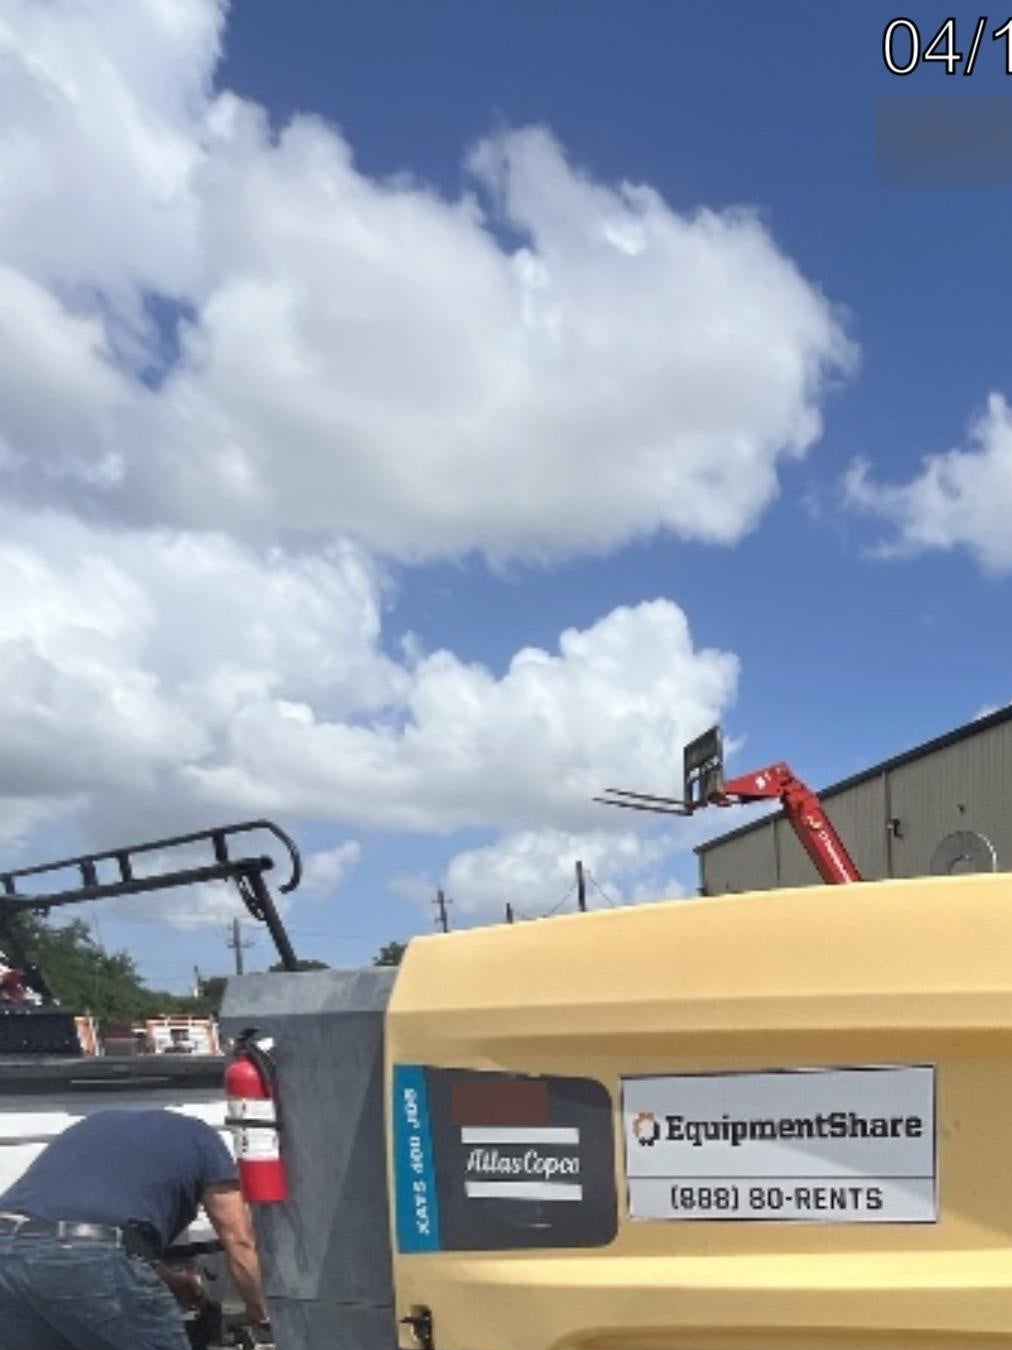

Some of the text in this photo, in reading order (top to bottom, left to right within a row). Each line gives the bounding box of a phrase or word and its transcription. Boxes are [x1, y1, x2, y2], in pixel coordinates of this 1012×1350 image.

[664, 1112, 923, 1147] EquipmentShare
[465, 1148, 580, 1181] Atlas Copco
[670, 1184, 884, 1212] (888) 80-RENTS
